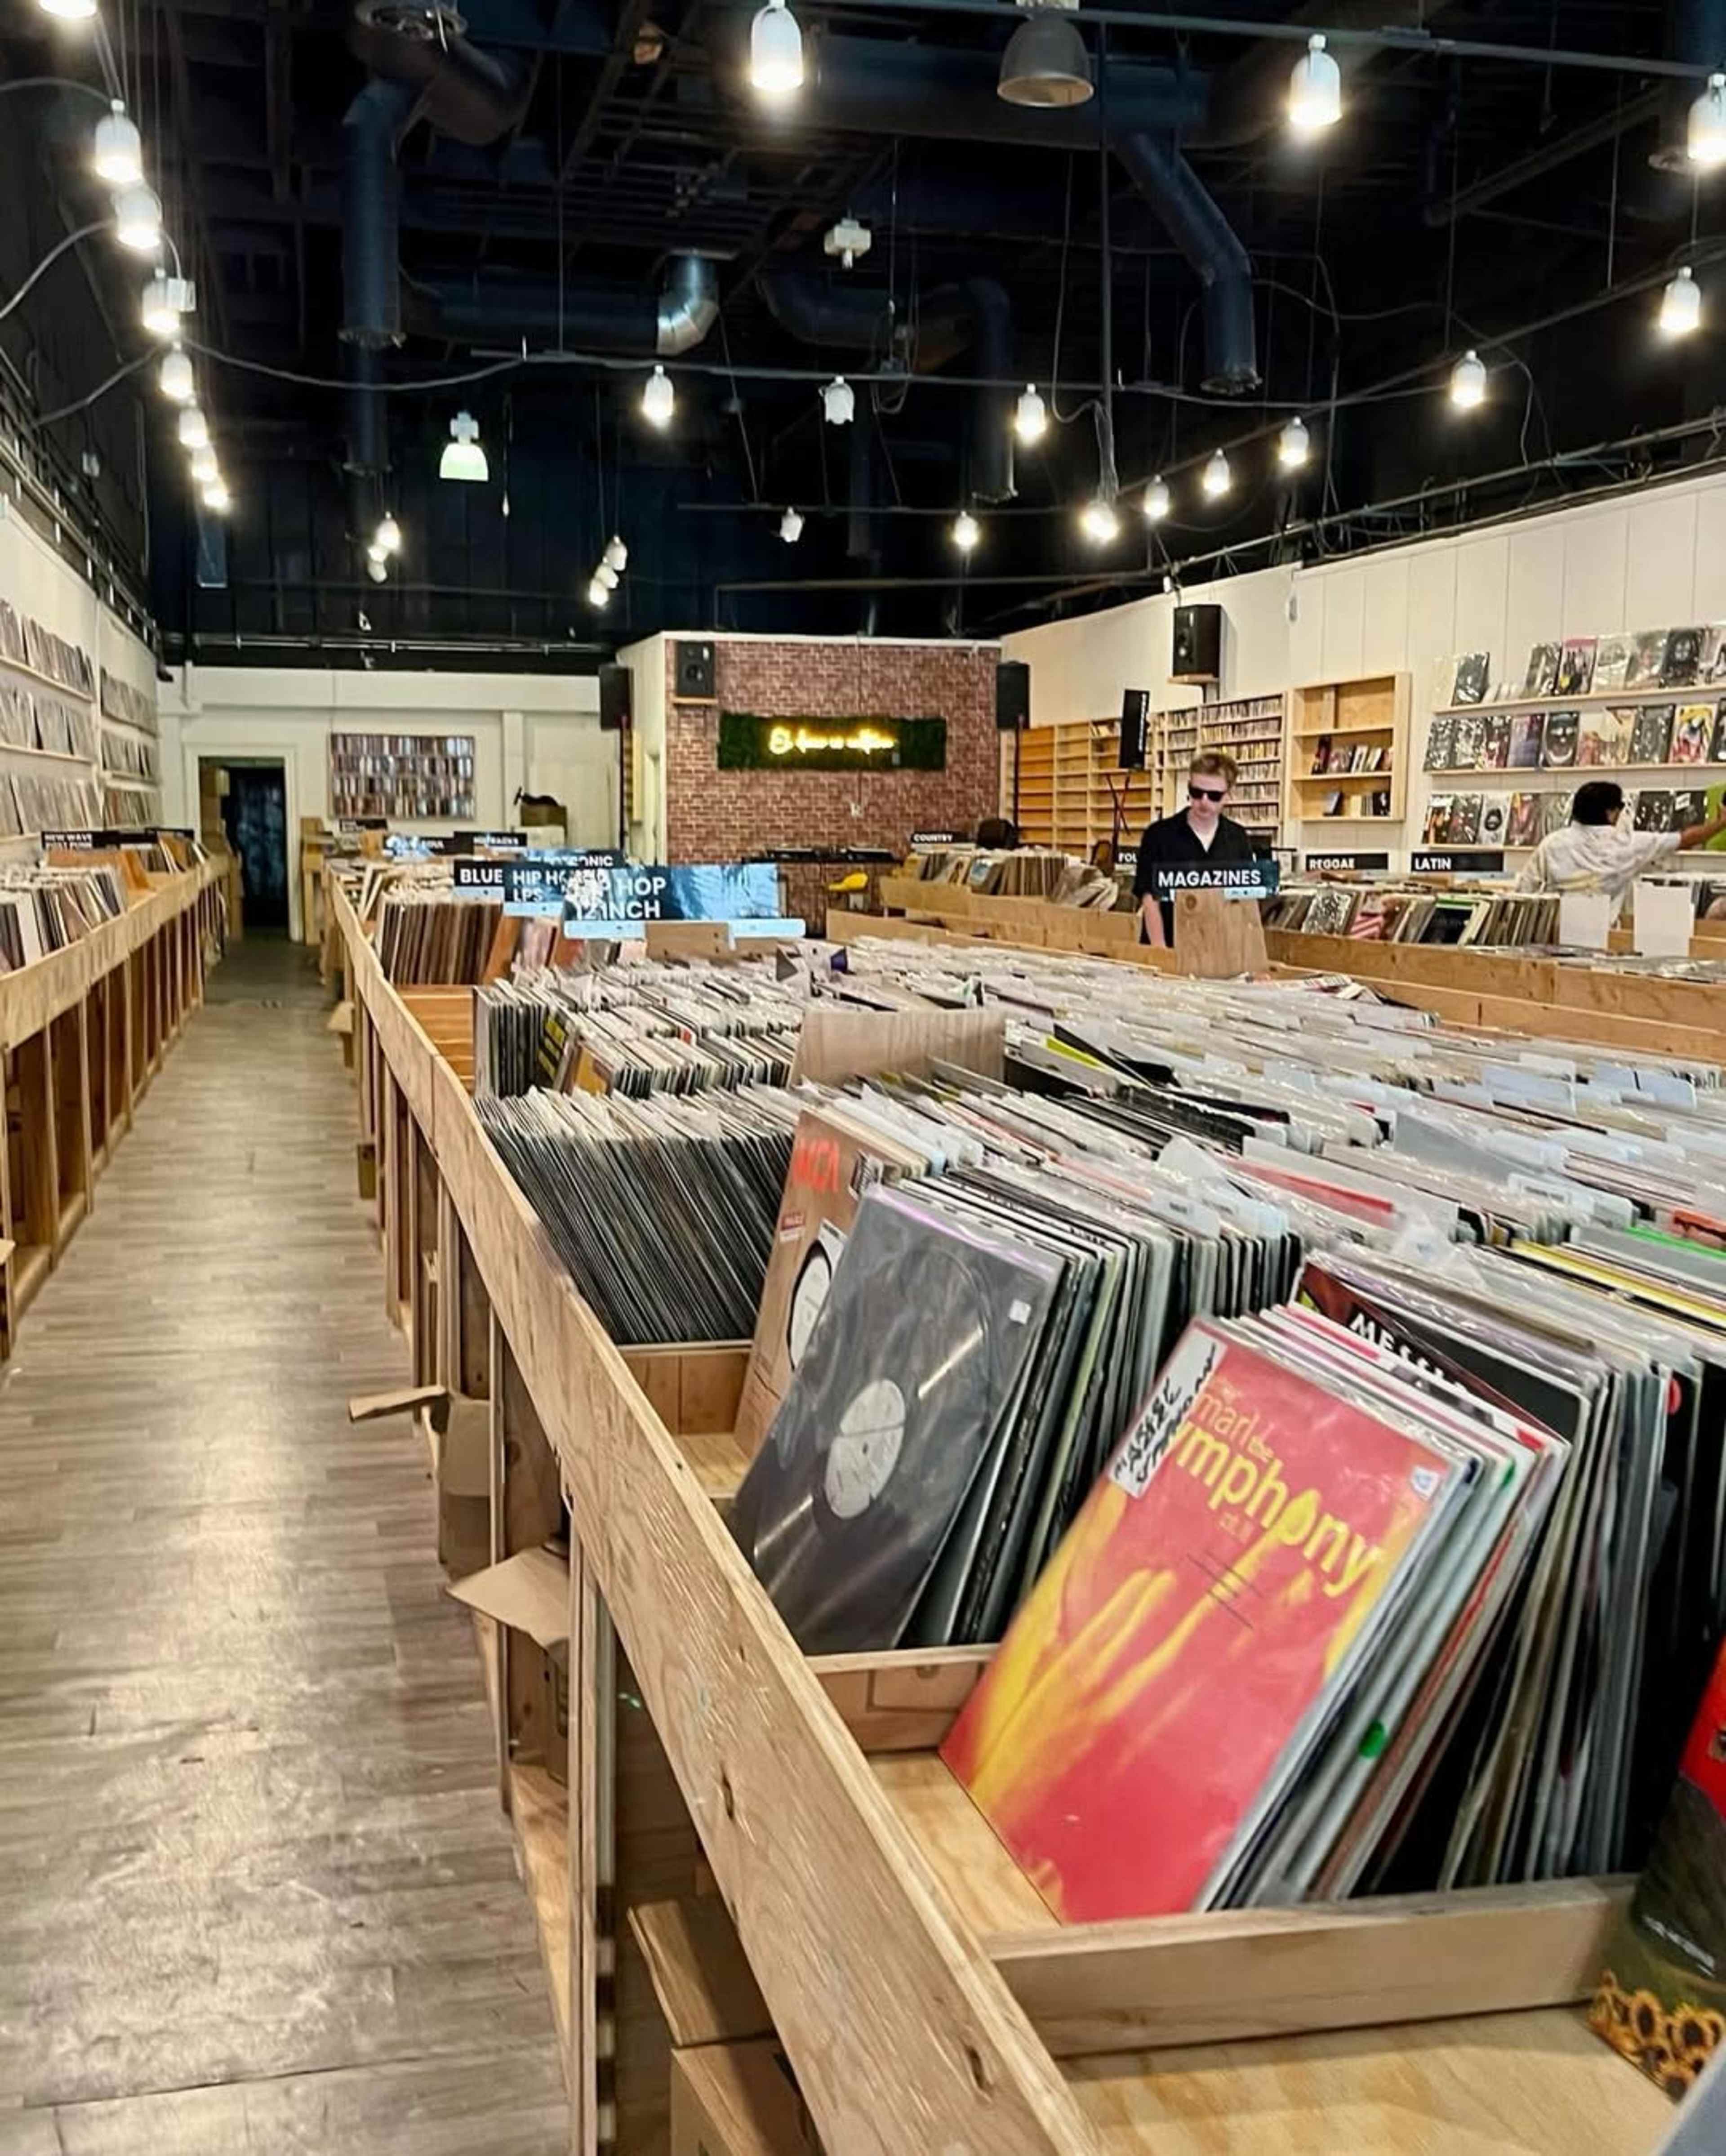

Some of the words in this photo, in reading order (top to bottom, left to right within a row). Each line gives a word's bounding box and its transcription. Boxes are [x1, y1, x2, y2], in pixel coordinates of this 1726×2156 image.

[1309, 858, 1355, 869] REGGAE
[1415, 857, 1451, 870] LATIN
[512, 871, 542, 885] HIP
[1158, 870, 1261, 887] MAGAZINES
[618, 877, 667, 896] HOP
[514, 887, 544, 902] LPS
